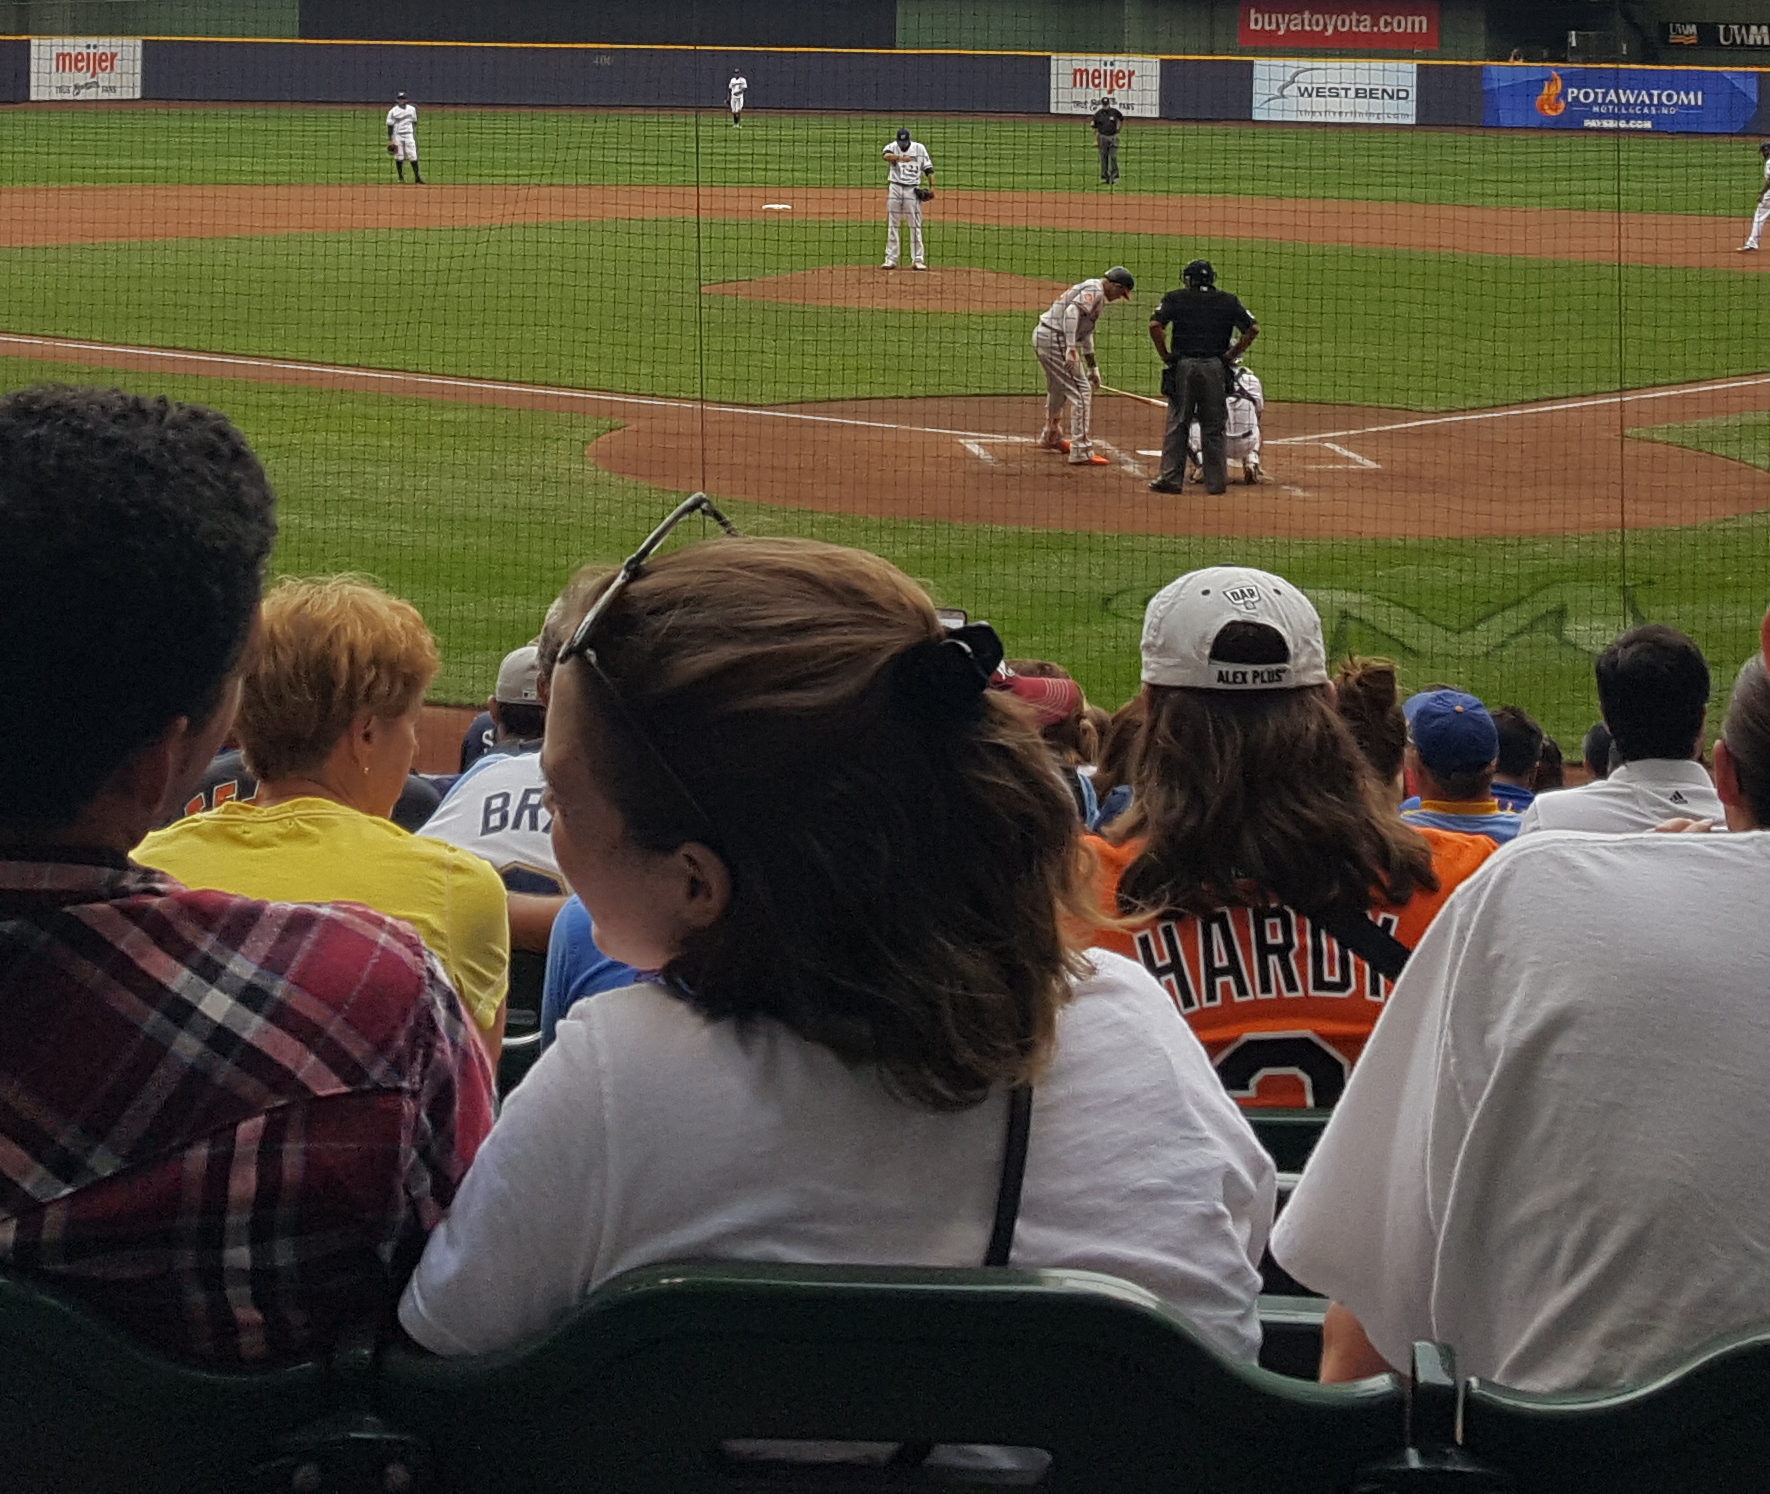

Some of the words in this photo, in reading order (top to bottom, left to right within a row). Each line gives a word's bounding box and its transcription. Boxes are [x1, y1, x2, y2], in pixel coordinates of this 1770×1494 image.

[1250, 10, 1429, 35] buyatoyota.com
[1072, 60, 1136, 94] meijer
[1297, 84, 1353, 100] WEST
[1354, 85, 1411, 101] BEND
[1568, 86, 1703, 107] POTAWATOMI
[1217, 670, 1247, 683] ALEX
[1252, 669, 1282, 683] PLUS
[480, 787, 553, 836] BR
